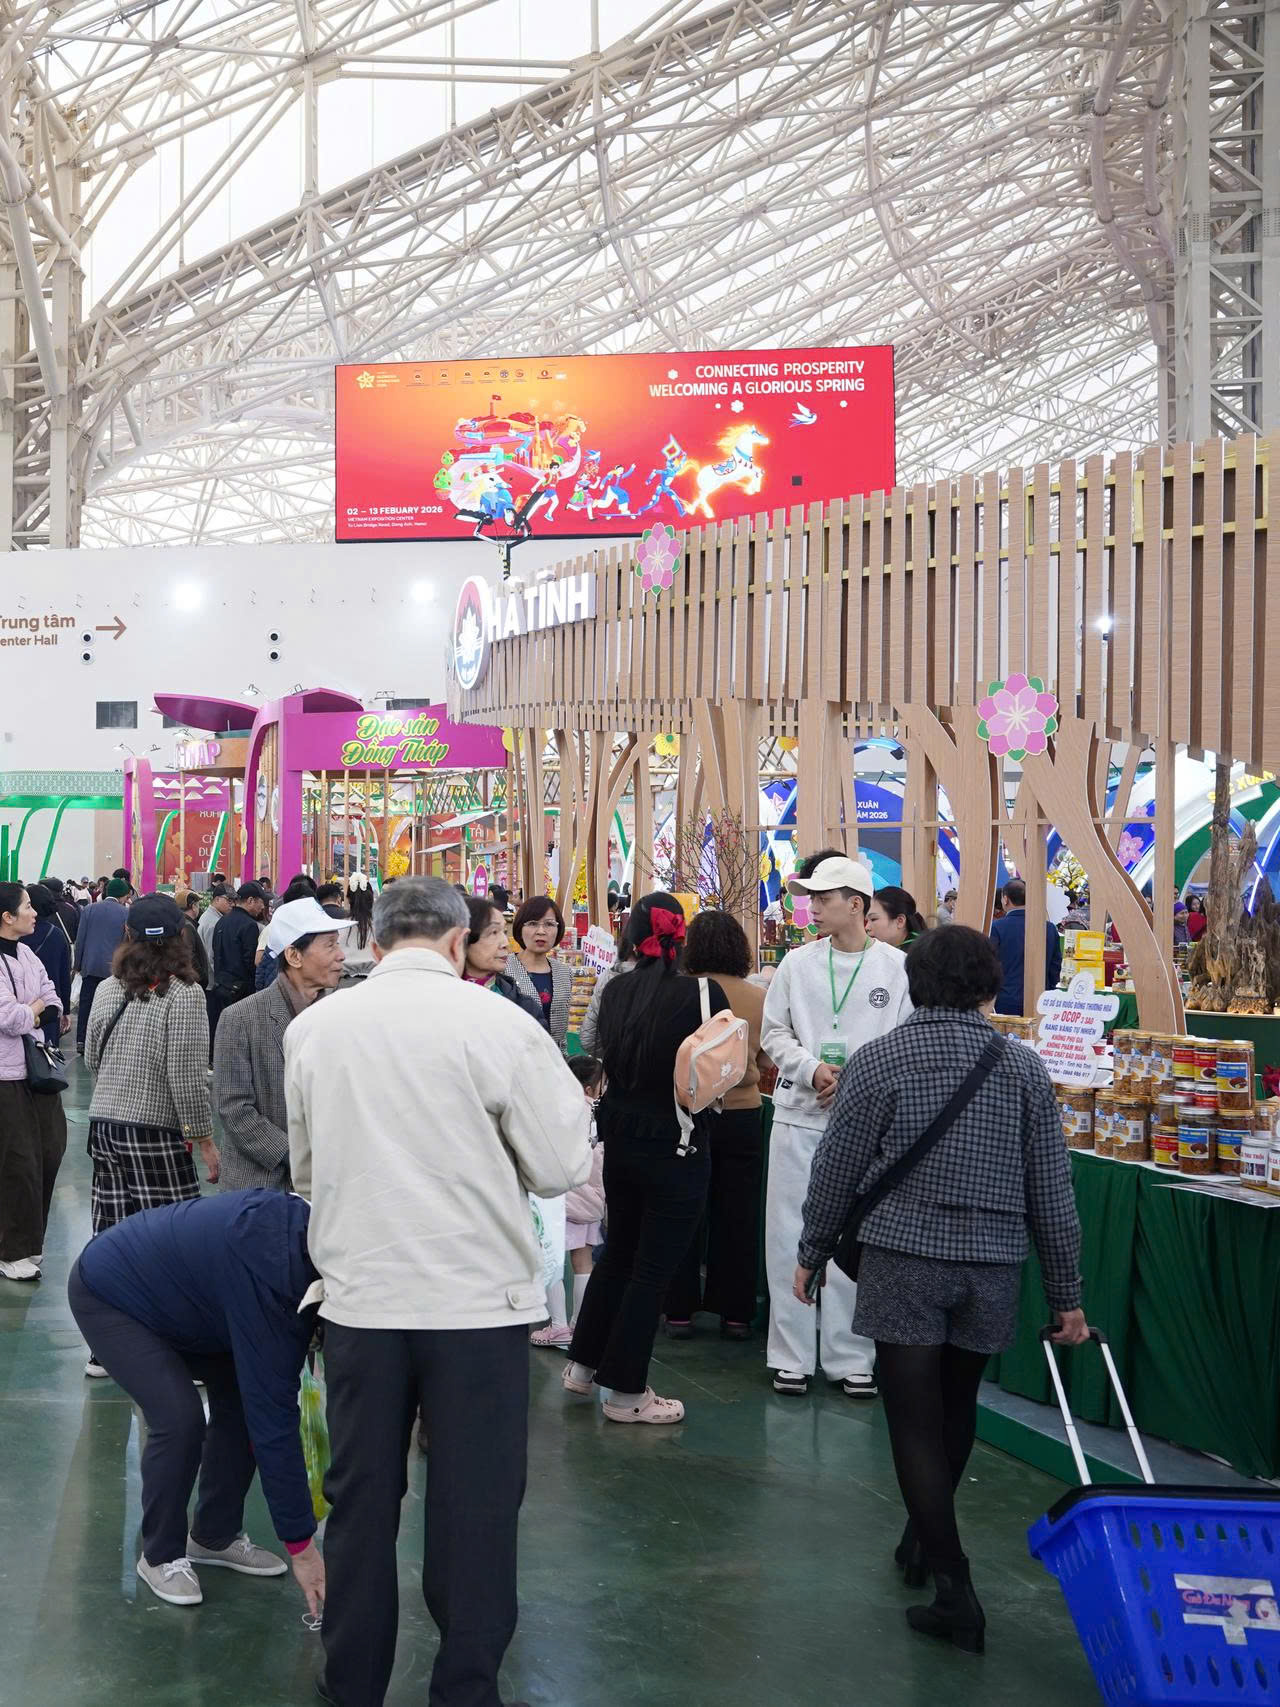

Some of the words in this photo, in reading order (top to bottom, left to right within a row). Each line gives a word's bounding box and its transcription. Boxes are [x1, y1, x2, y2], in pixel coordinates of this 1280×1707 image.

[695, 363, 779, 378] CONNECTING
[784, 360, 865, 376] PROSPERITY
[649, 382, 728, 397] WELCOMING
[732, 382, 742, 395] A
[745, 380, 813, 394] GLORIOUS
[816, 378, 865, 392] SPRING
[347, 507, 358, 515] 02
[369, 507, 378, 515] 13
[380, 506, 419, 514] FEBUARY
[43, 613, 76, 629] tâm
[34, 634, 59, 646] Hall
[357, 714, 404, 741] Đặc
[402, 713, 439, 737] sản
[341, 738, 398, 767] Đồng
[399, 738, 450, 767] Tháp
[582, 941, 596, 956] TEAM
[1061, 1010, 1082, 1023] OCOP
